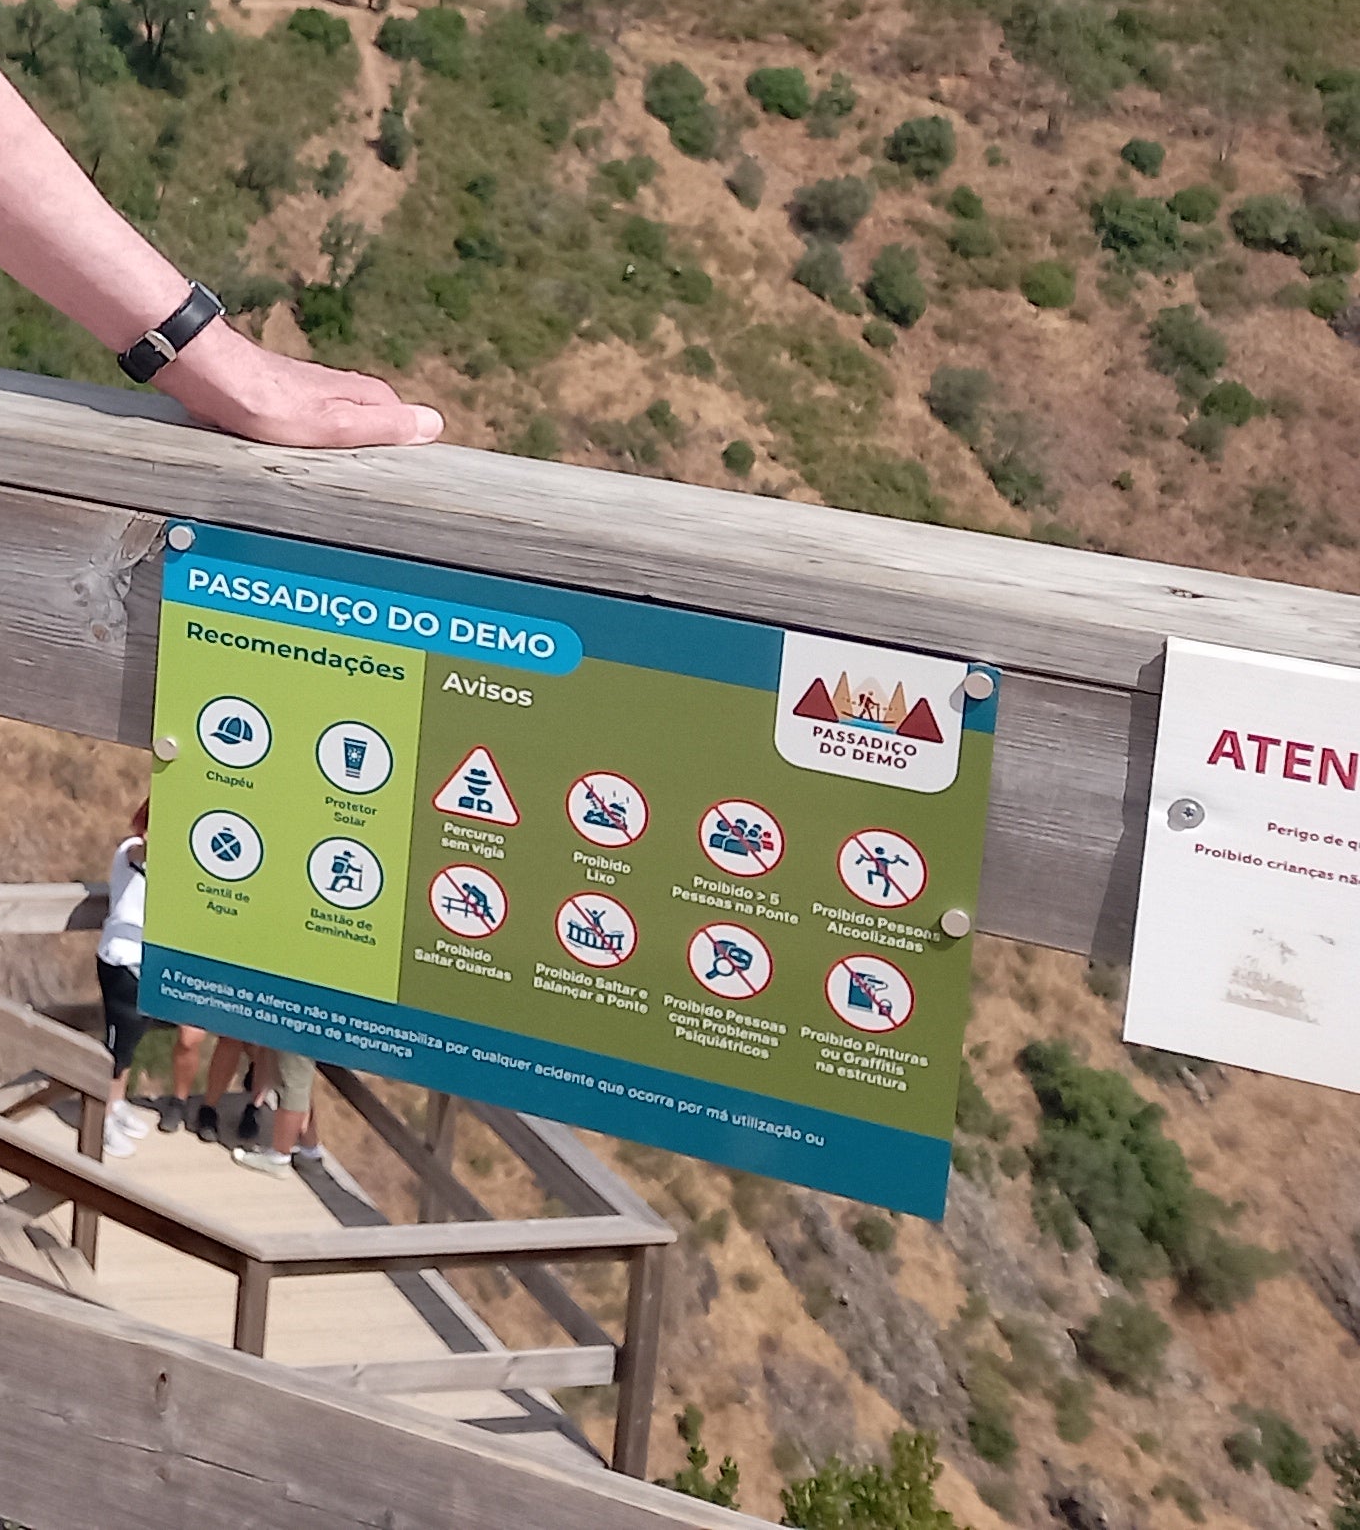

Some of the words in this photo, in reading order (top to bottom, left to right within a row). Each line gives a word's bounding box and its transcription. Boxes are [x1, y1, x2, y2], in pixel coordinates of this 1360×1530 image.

[188, 568, 379, 626] PASSADIÇO
[387, 606, 440, 637] DO
[449, 618, 556, 659] DEMO
[186, 621, 406, 681] Recomendações
[442, 672, 534, 708] Avisos
[813, 726, 917, 756] PASSADIÇO
[819, 742, 846, 757] DO
[852, 749, 907, 769] DEMO
[1207, 729, 1359, 791] ATEN
[206, 770, 254, 789] Chapéu
[325, 796, 378, 816] Protetor
[334, 811, 367, 828] Solar
[441, 836, 470, 852] sem
[472, 843, 505, 860] vigia
[443, 821, 505, 845] Percurso
[1267, 822, 1319, 843] Perigo
[1324, 834, 1344, 846] de
[573, 851, 631, 874] Proibido
[586, 868, 616, 885] Lixo
[1195, 843, 1263, 866] Proibido
[1267, 859, 1334, 880] crianças
[196, 882, 232, 899] Cantil
[234, 892, 250, 903] de
[671, 886, 732, 911] Pessoas
[735, 902, 753, 916] na
[756, 907, 800, 925] Ponte
[693, 875, 754, 901] Proibido
[770, 893, 780, 905] 5
[305, 920, 376, 946] Caminhada
[356, 920, 373, 931] de
[812, 902, 874, 927] Proibido
[877, 917, 941, 943] Pessoas
[827, 922, 924, 953] Alcoolizadas
[414, 948, 454, 969] Saltar
[455, 959, 512, 982] Guardas
[436, 940, 492, 963] Proibido
[533, 977, 593, 1000] Balançar
[595, 992, 605, 1003] a
[607, 993, 649, 1014] Ponte
[535, 963, 593, 986] Proibido
[595, 977, 638, 998] Saltar
[663, 994, 723, 1019] Proibido
[725, 1010, 787, 1035] Pessoas
[668, 1011, 700, 1027] com
[702, 1018, 779, 1047] Problemas
[255, 1009, 278, 1025] das
[280, 1014, 322, 1036] regras
[324, 1027, 342, 1041] de
[344, 1032, 414, 1058] segurança
[675, 1026, 770, 1060] Psiquiátricos
[800, 1026, 863, 1051] Proibido
[865, 1042, 929, 1067] Pinturas
[161, 968, 171, 980] A
[174, 971, 234, 997] Freguesia
[236, 988, 254, 1001] de
[331, 1012, 347, 1025] se
[349, 1017, 443, 1049] responsabiliza
[445, 1041, 469, 1055] por
[471, 1048, 532, 1071] qualquer
[534, 1064, 594, 1087] acidente
[597, 1079, 625, 1095] que
[627, 1087, 675, 1108] ocorra
[677, 1100, 703, 1115] por
[706, 1106, 729, 1122] má
[732, 1114, 802, 1141] utilização
[805, 1132, 825, 1147] ou
[820, 1047, 841, 1061] ou
[843, 1051, 905, 1076] Graffitis
[815, 1061, 835, 1074] na
[837, 1067, 908, 1092] estrutura
